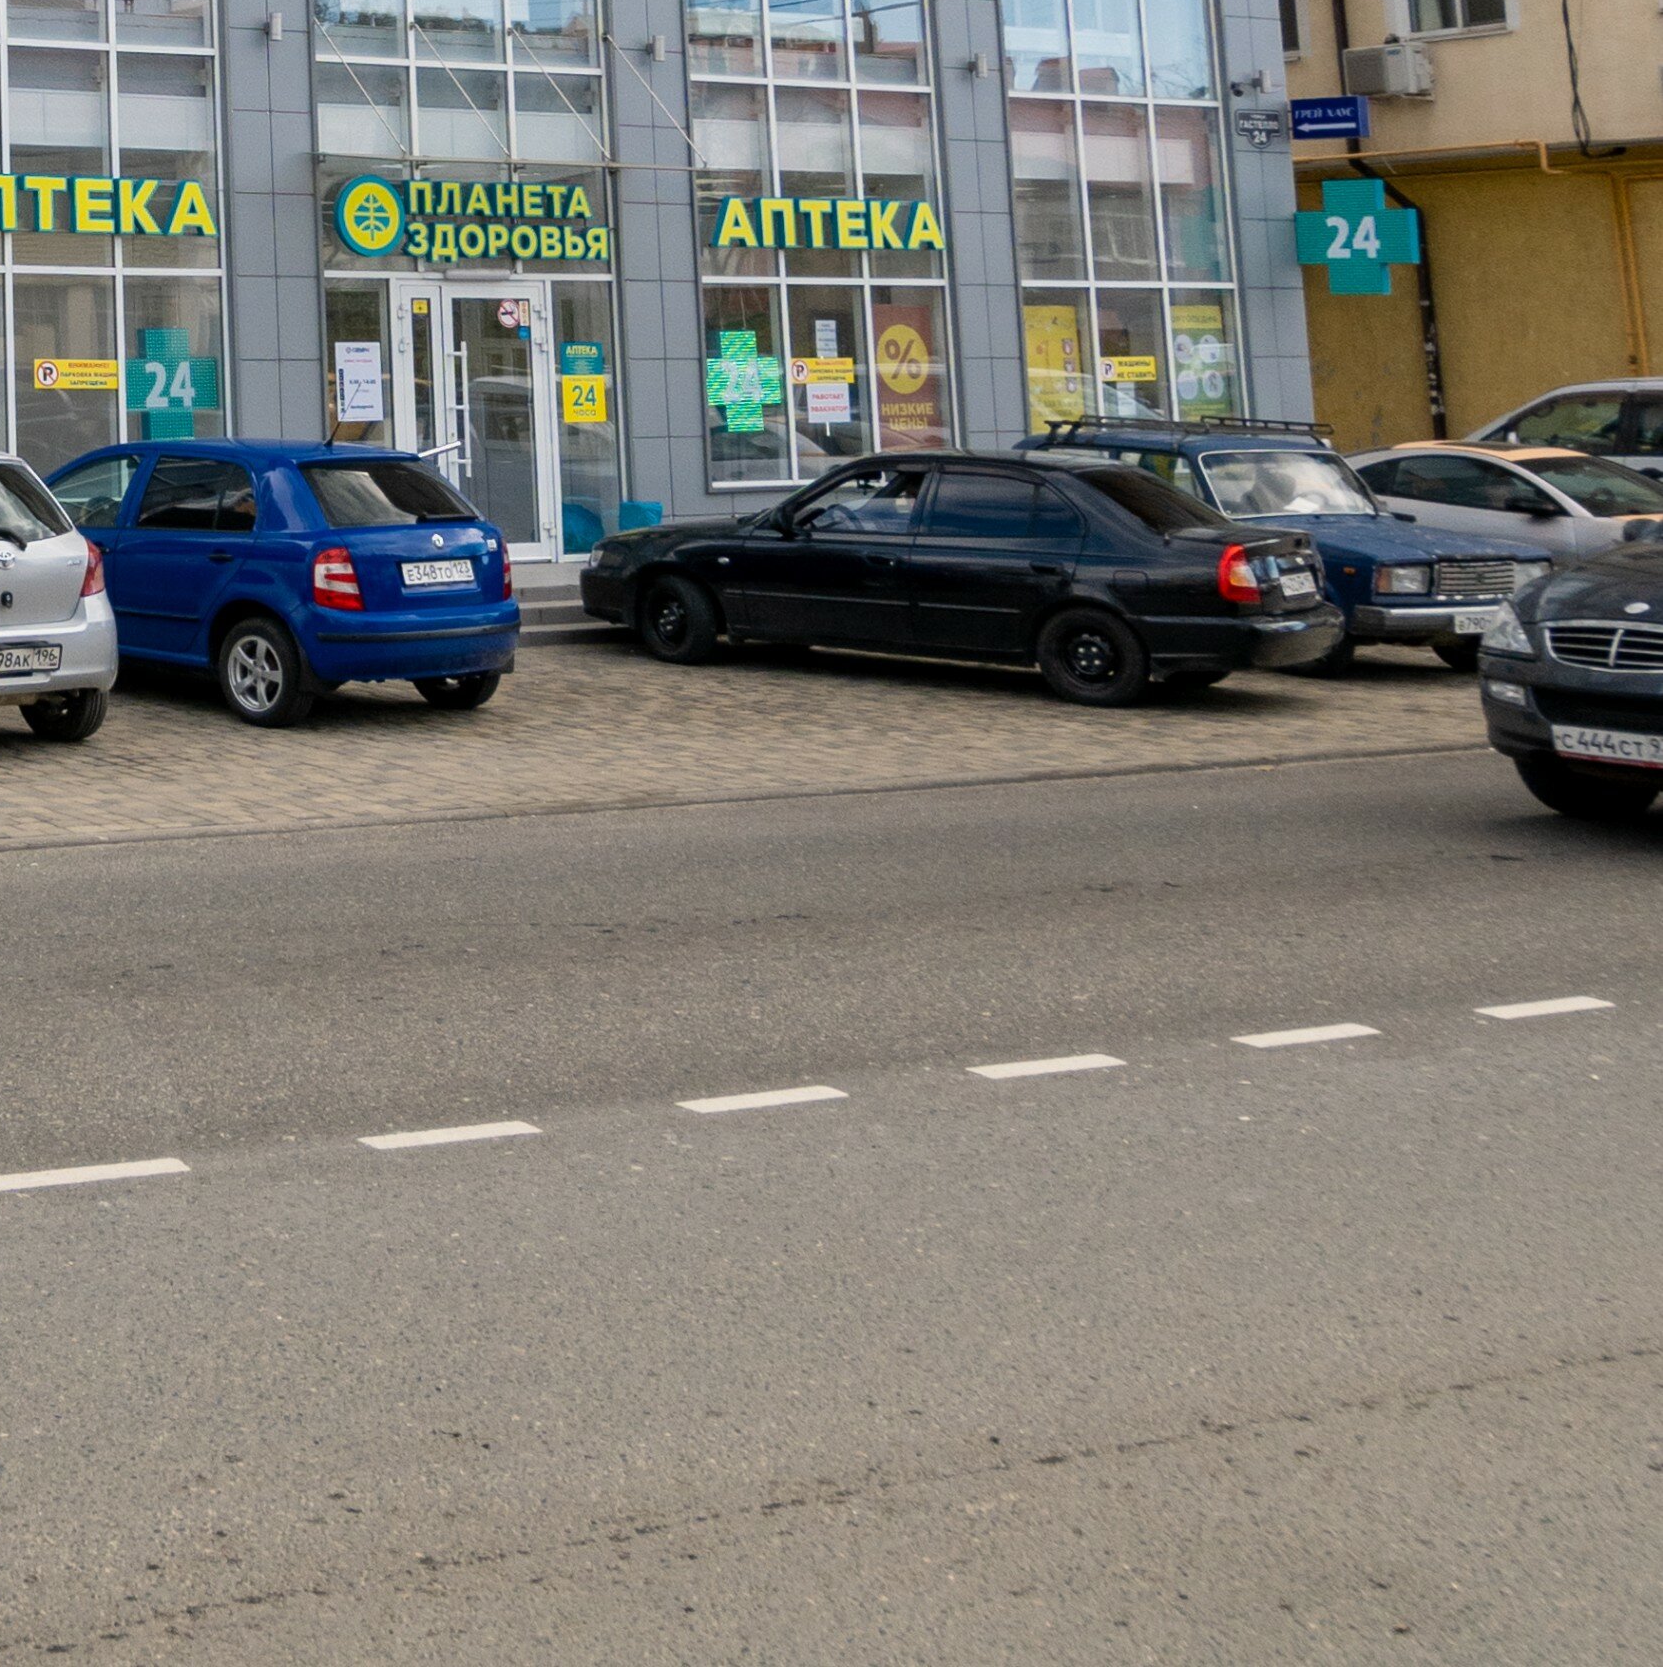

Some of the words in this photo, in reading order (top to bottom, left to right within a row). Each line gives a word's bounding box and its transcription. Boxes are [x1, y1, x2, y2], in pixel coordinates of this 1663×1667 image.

[1253, 131, 1267, 143] 24
[406, 181, 592, 218] ПЛАНЕТА
[714, 197, 946, 250] АПТЕКА
[406, 222, 609, 262] ЗДОРОВЬЯ
[1325, 215, 1381, 259] 24
[566, 345, 598, 356] АПТЕКА
[145, 361, 195, 408] 24
[720, 360, 762, 402] 24
[572, 385, 596, 406] 24
[812, 392, 844, 401] РАБОТАЕТ
[811, 404, 848, 413] ЭВАКУАТОР
[881, 402, 934, 416] НИЗКИЕ
[889, 417, 928, 431] ЦЕНЫ
[35, 649, 54, 662] 196
